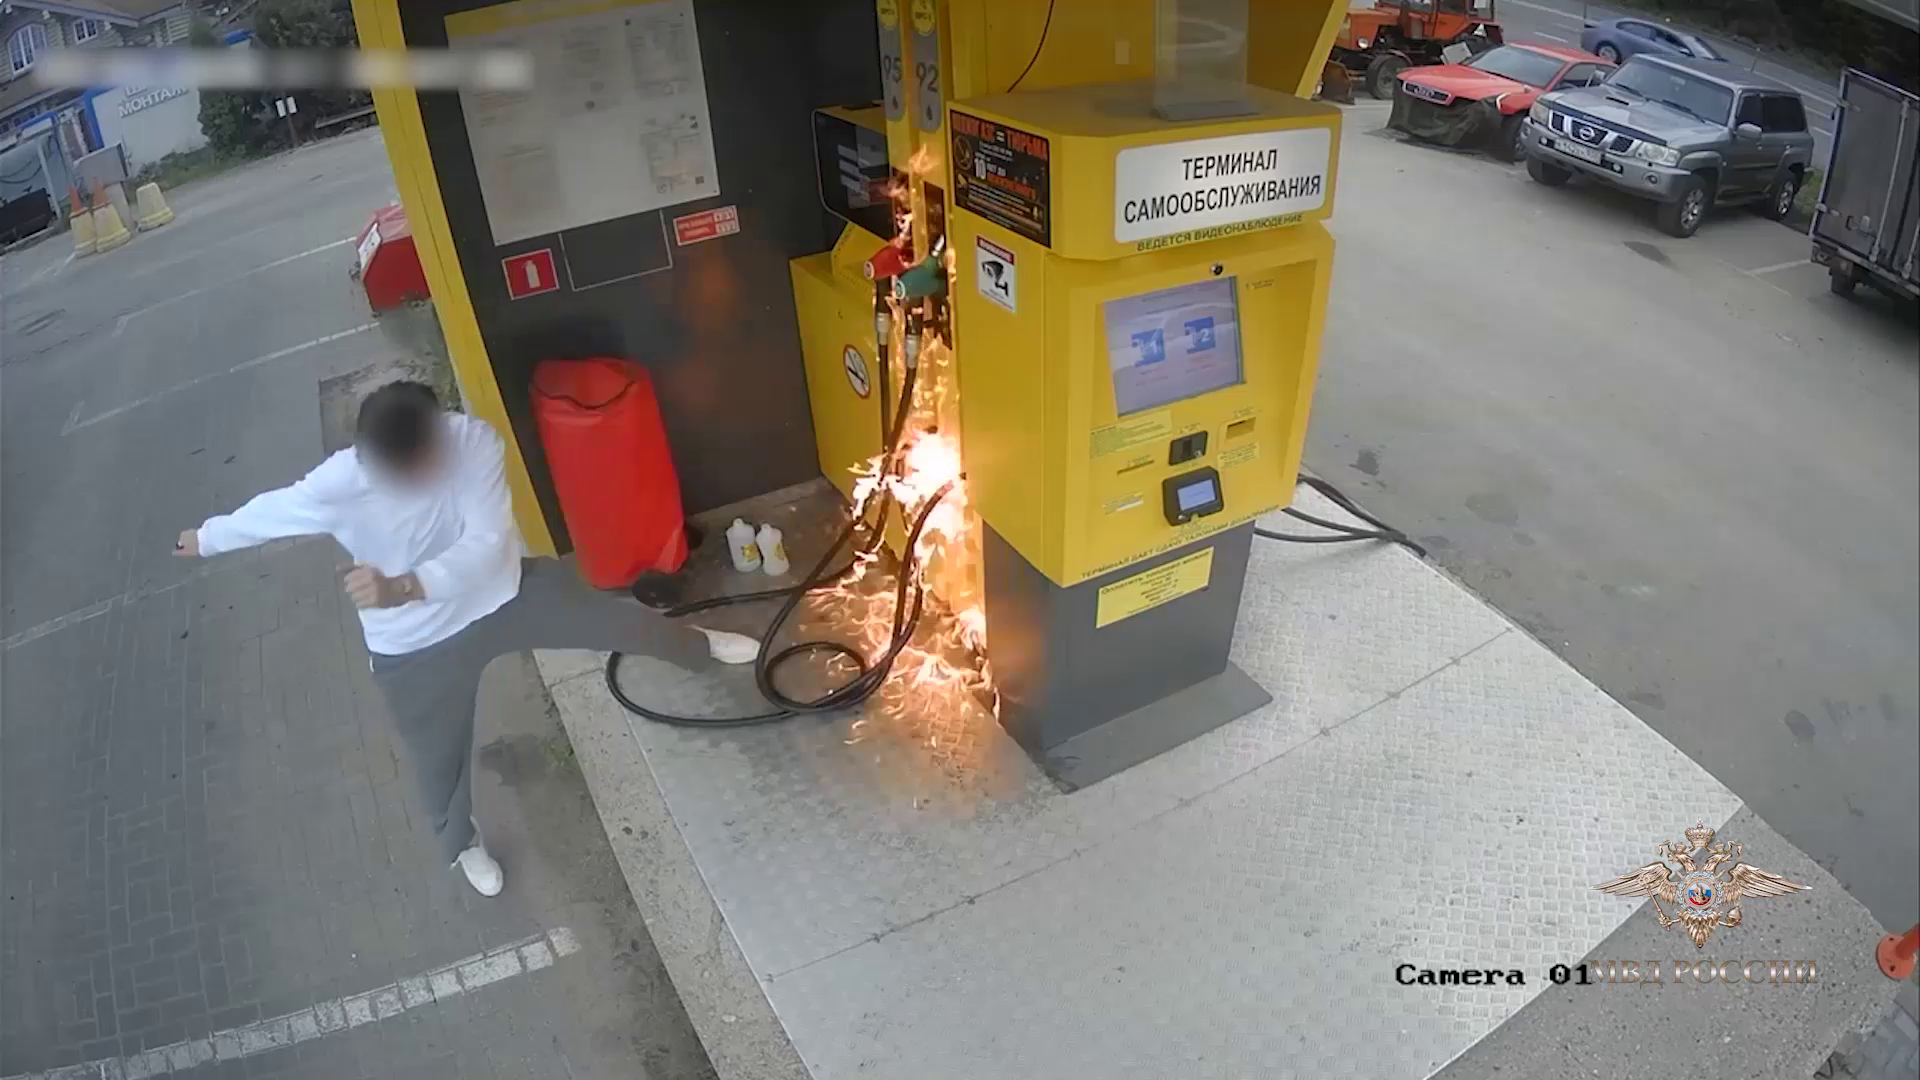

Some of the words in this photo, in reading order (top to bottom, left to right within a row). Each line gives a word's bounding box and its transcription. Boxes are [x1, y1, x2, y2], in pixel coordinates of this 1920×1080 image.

[883, 55, 903, 83] 95
[916, 62, 939, 93] 92
[975, 158, 986, 179] 10
[1183, 149, 1278, 180] ТЕРМИНАЛ
[1124, 175, 1321, 223] САМООБСЛУЖИВАНИЯ
[1137, 233, 1192, 251] ВЕДЕТСЯ
[1194, 213, 1303, 241] ВИДЕОНАБЛЮДЕНИЕ
